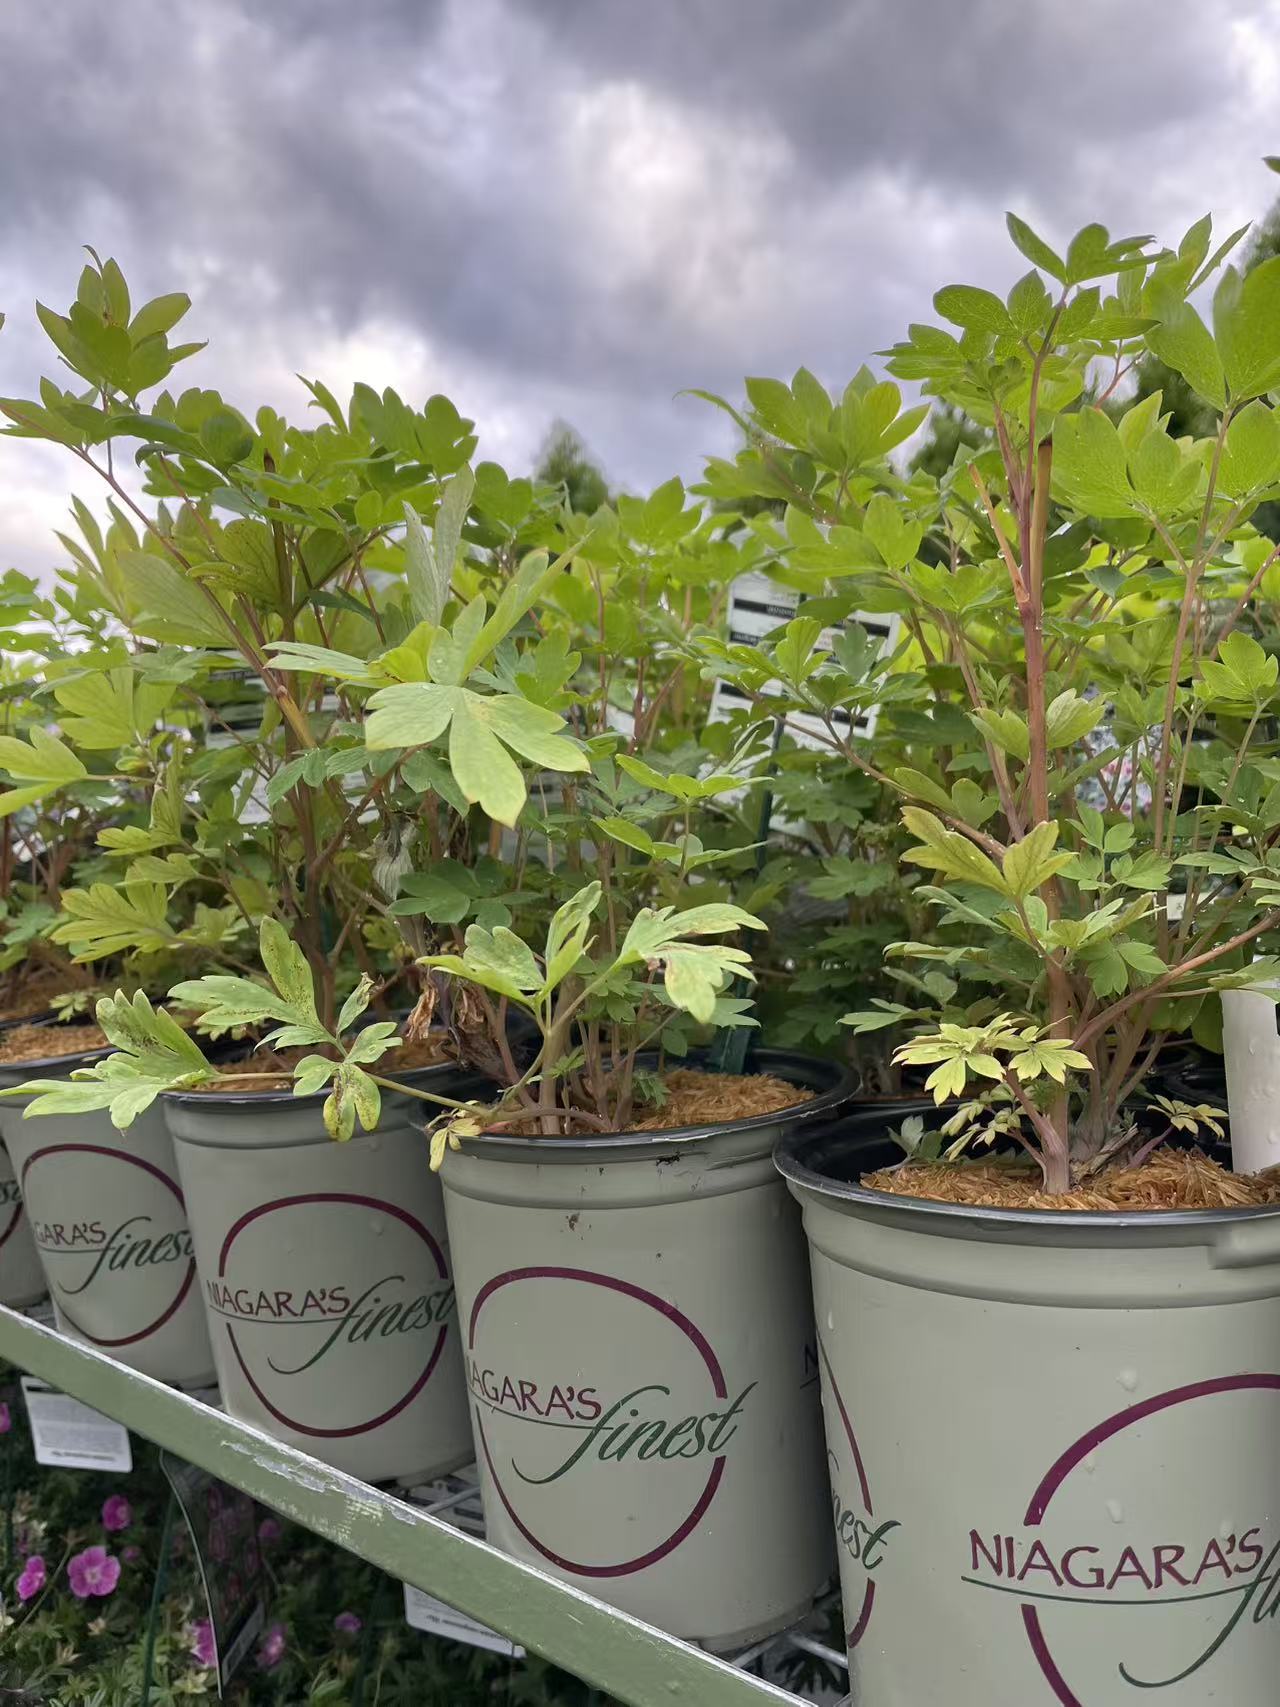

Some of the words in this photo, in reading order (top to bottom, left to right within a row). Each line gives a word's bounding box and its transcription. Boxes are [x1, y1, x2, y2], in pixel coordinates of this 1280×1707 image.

[206, 1279, 351, 1317] NIAGARA'S
[511, 1381, 759, 1484] finest
[969, 1527, 1263, 1590] NIAGARA'S
